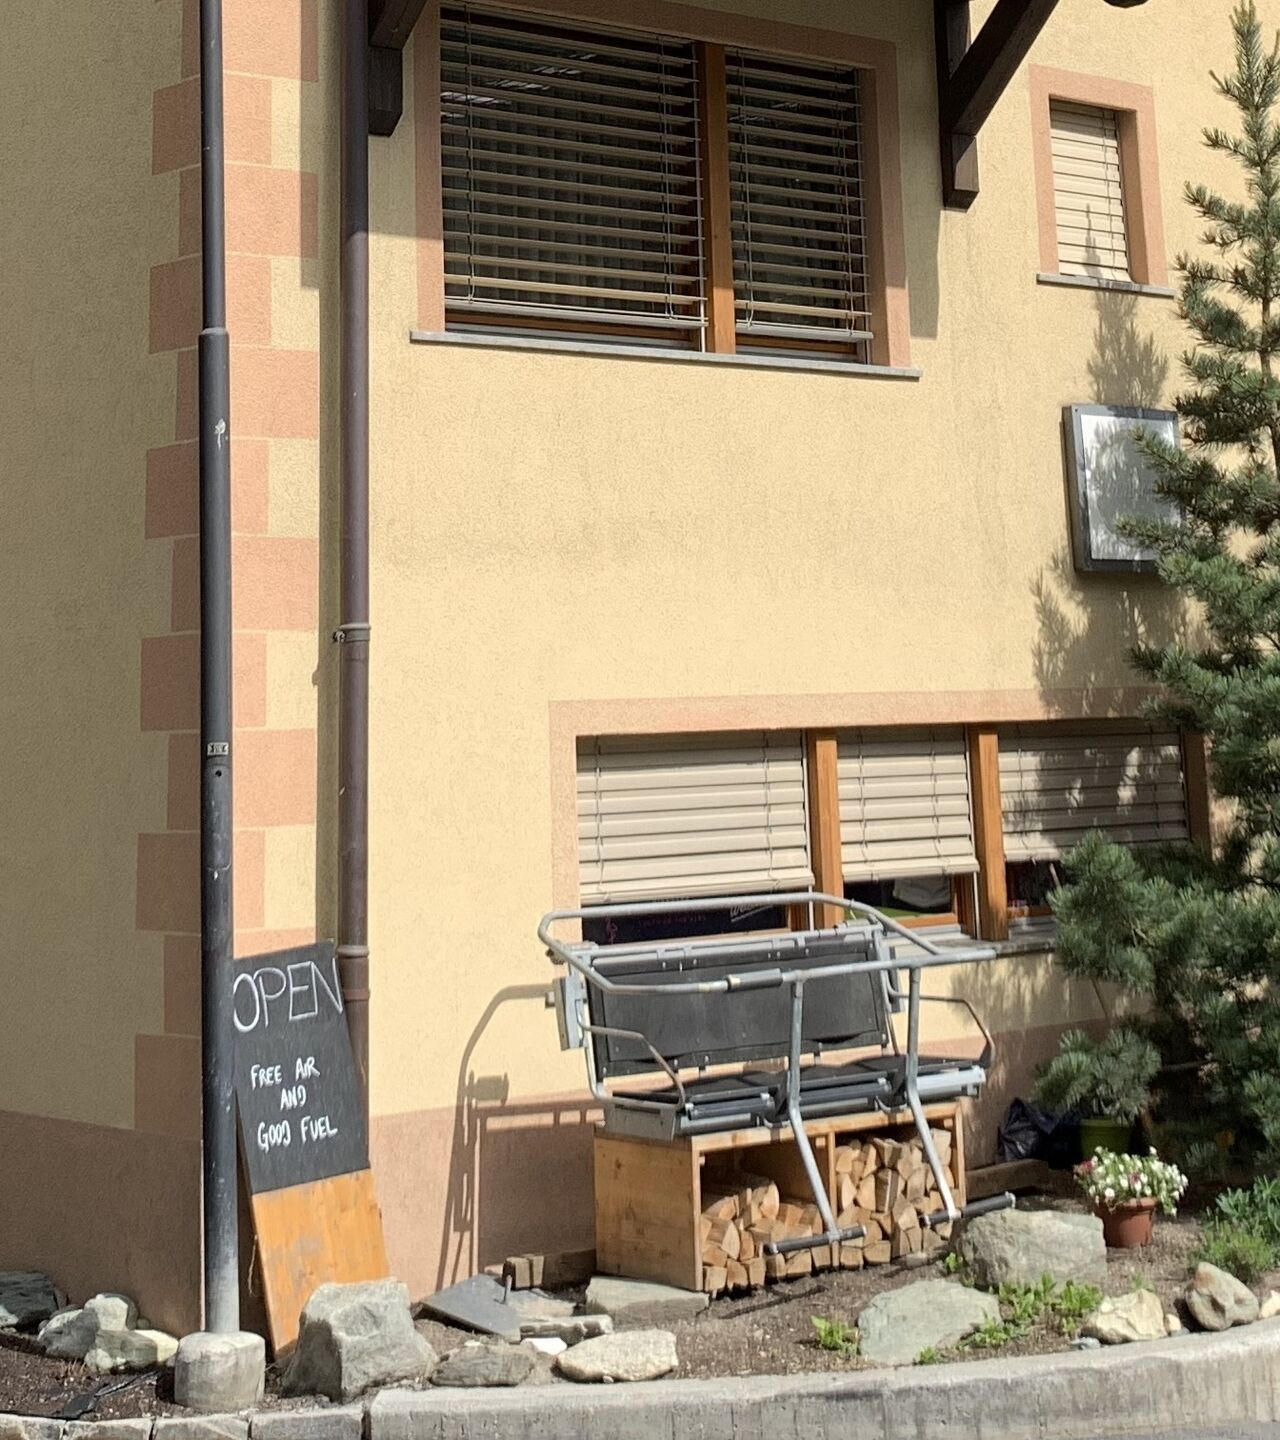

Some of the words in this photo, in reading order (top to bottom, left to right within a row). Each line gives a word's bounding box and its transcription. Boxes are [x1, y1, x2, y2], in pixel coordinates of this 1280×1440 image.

[233, 957, 344, 1033] OPEN
[250, 1063, 283, 1091] FREE
[280, 1084, 307, 1111] AND
[257, 1120, 291, 1155] GOOD
[300, 1114, 339, 1145] FUEL
